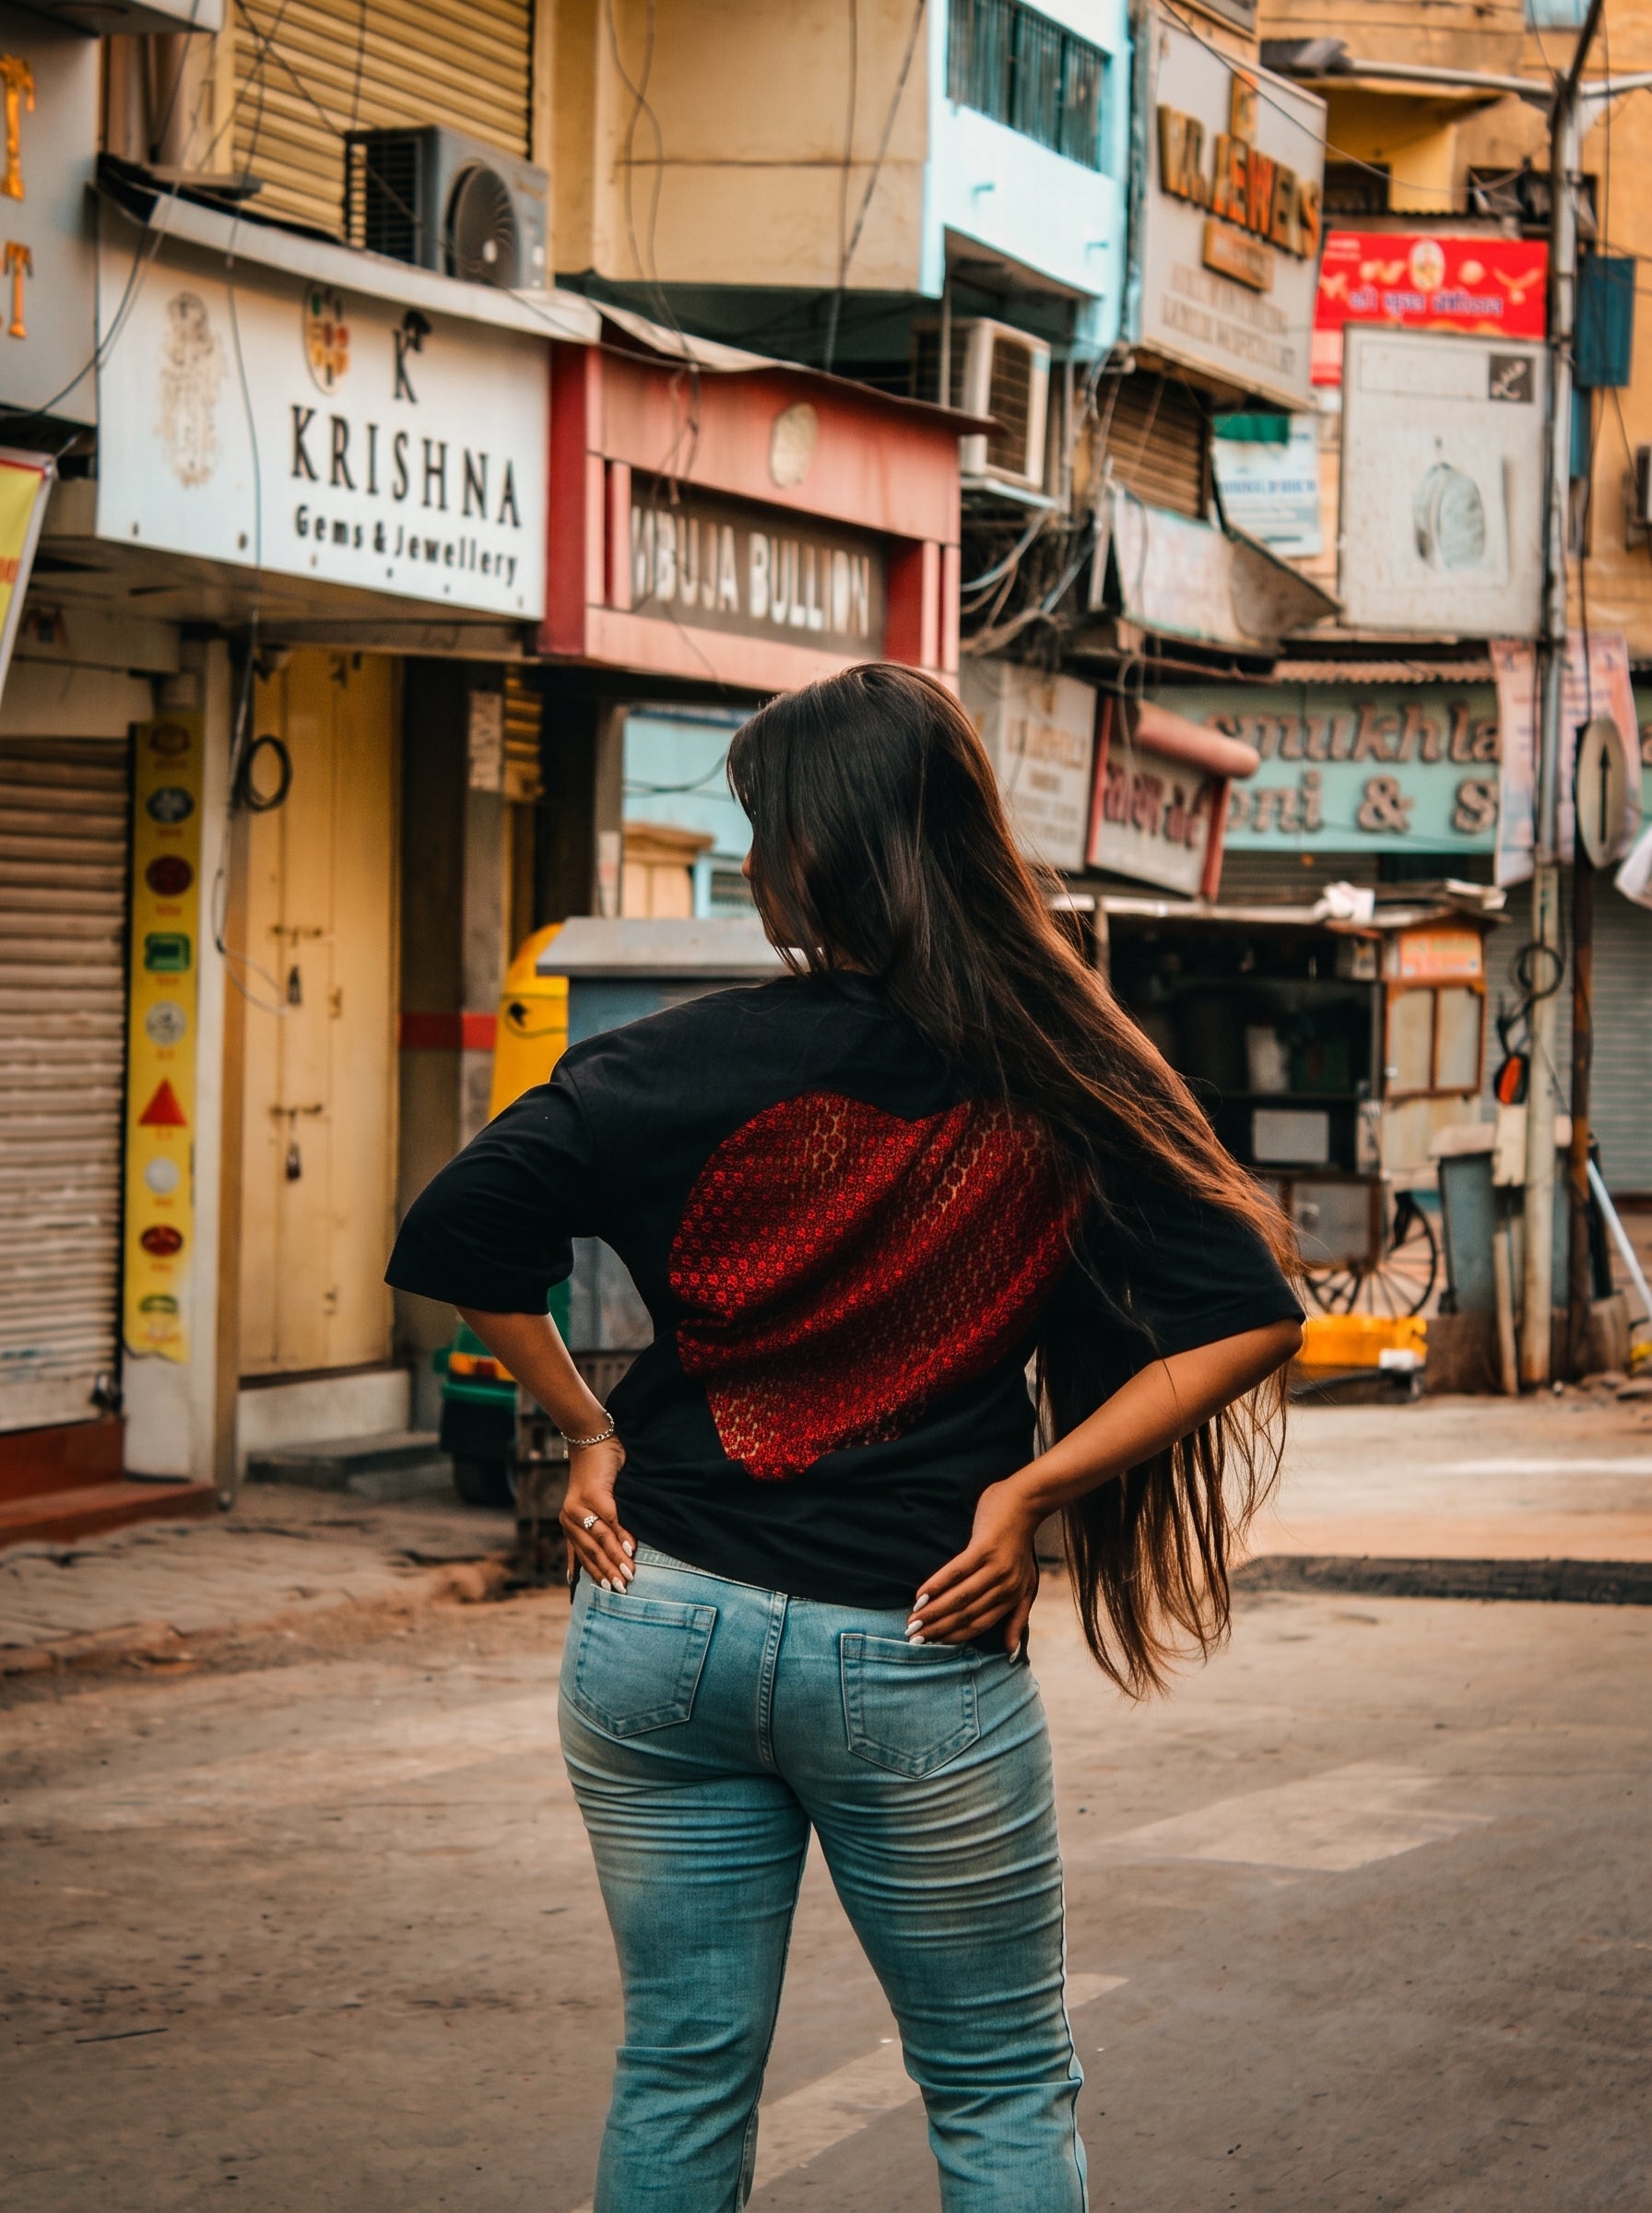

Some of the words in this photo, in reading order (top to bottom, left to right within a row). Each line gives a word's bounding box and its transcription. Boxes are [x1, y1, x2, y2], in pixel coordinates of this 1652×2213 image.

[290, 403, 521, 530] KRISHNA
[294, 503, 363, 551] Gems
[374, 519, 386, 553] &
[395, 523, 518, 588] Jewellery
[749, 530, 869, 637] BULLION
[1357, 773, 1415, 834] &
